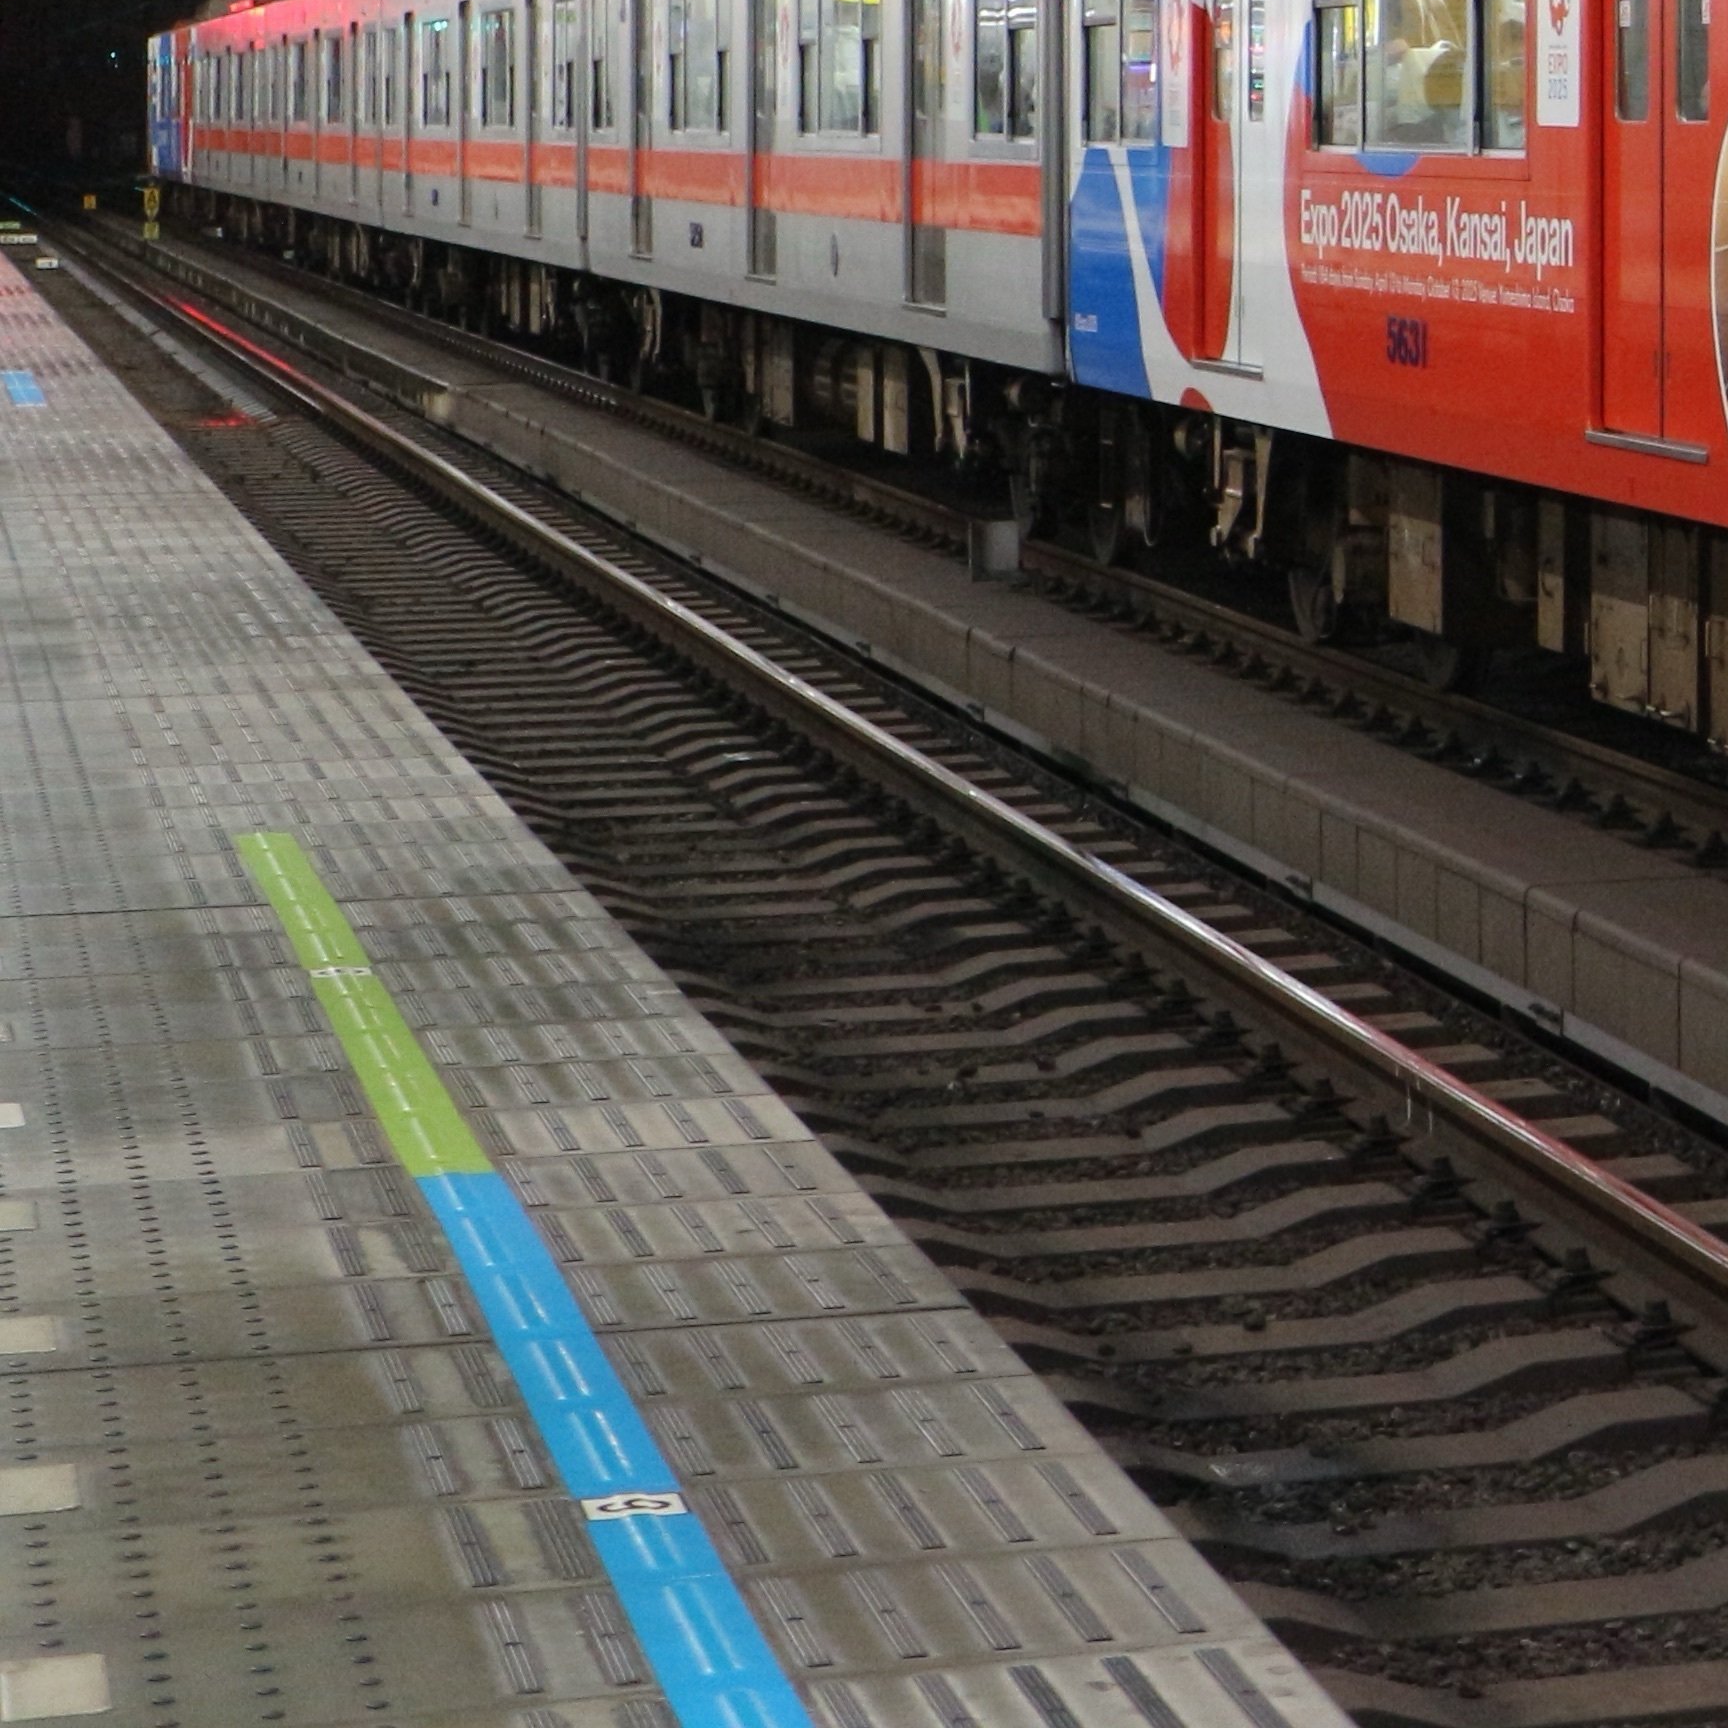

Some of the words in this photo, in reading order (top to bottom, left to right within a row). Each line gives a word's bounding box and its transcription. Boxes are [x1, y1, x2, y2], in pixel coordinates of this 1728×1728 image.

[1301, 189, 1337, 259] Expo
[1341, 191, 1383, 252] 2025
[1386, 193, 1442, 266] Osaka,
[1446, 196, 1510, 272] Kansai,
[1514, 200, 1573, 281] Japan
[1386, 314, 1428, 368] 5631
